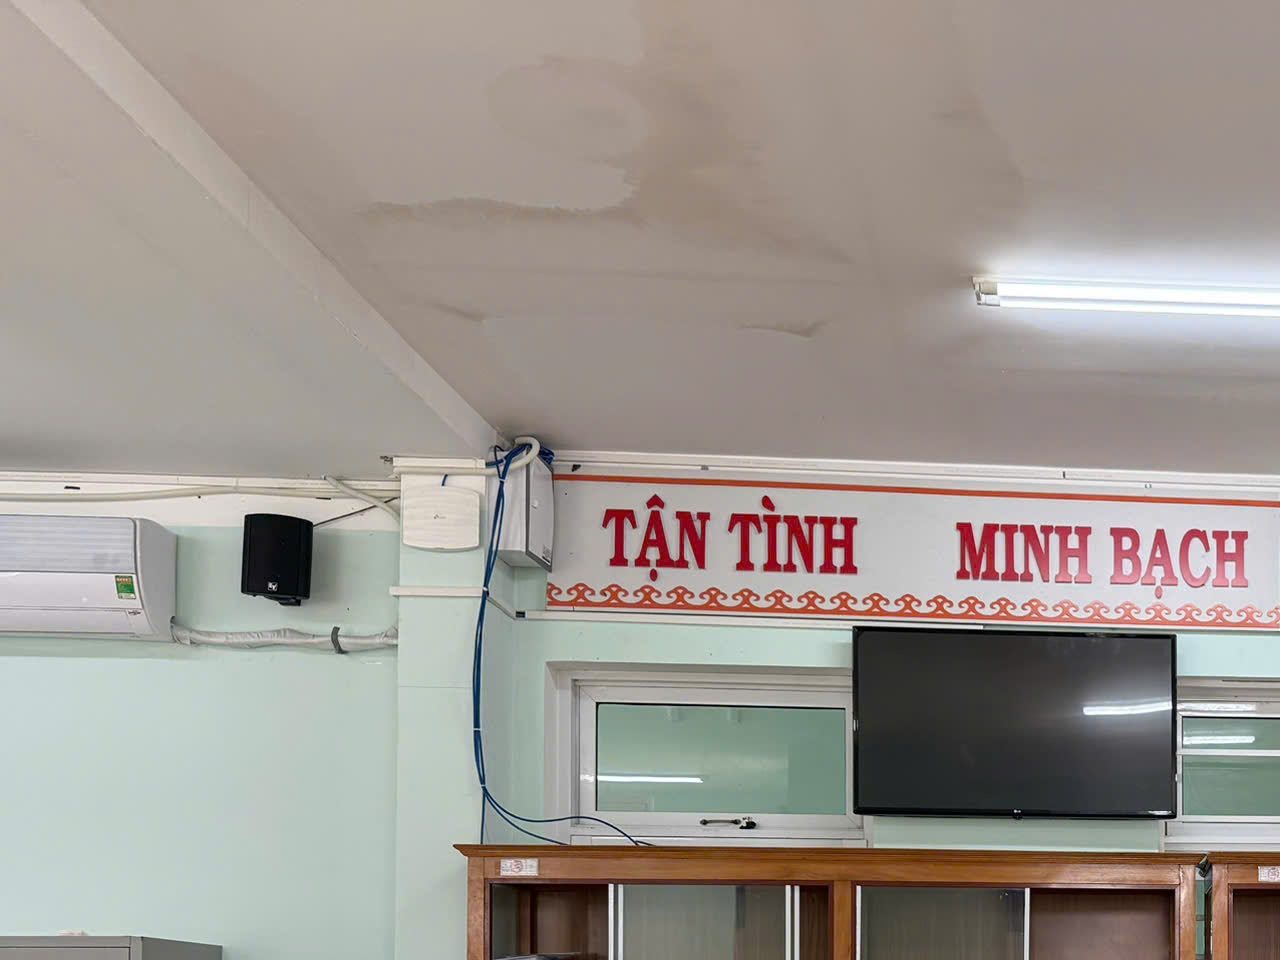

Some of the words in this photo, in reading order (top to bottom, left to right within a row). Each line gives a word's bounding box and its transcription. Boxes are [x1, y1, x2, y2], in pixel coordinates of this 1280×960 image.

[602, 494, 711, 583] TẬN
[728, 496, 859, 576] TÌNH
[955, 521, 1092, 584] MINH
[1109, 527, 1249, 600] BẠCH
